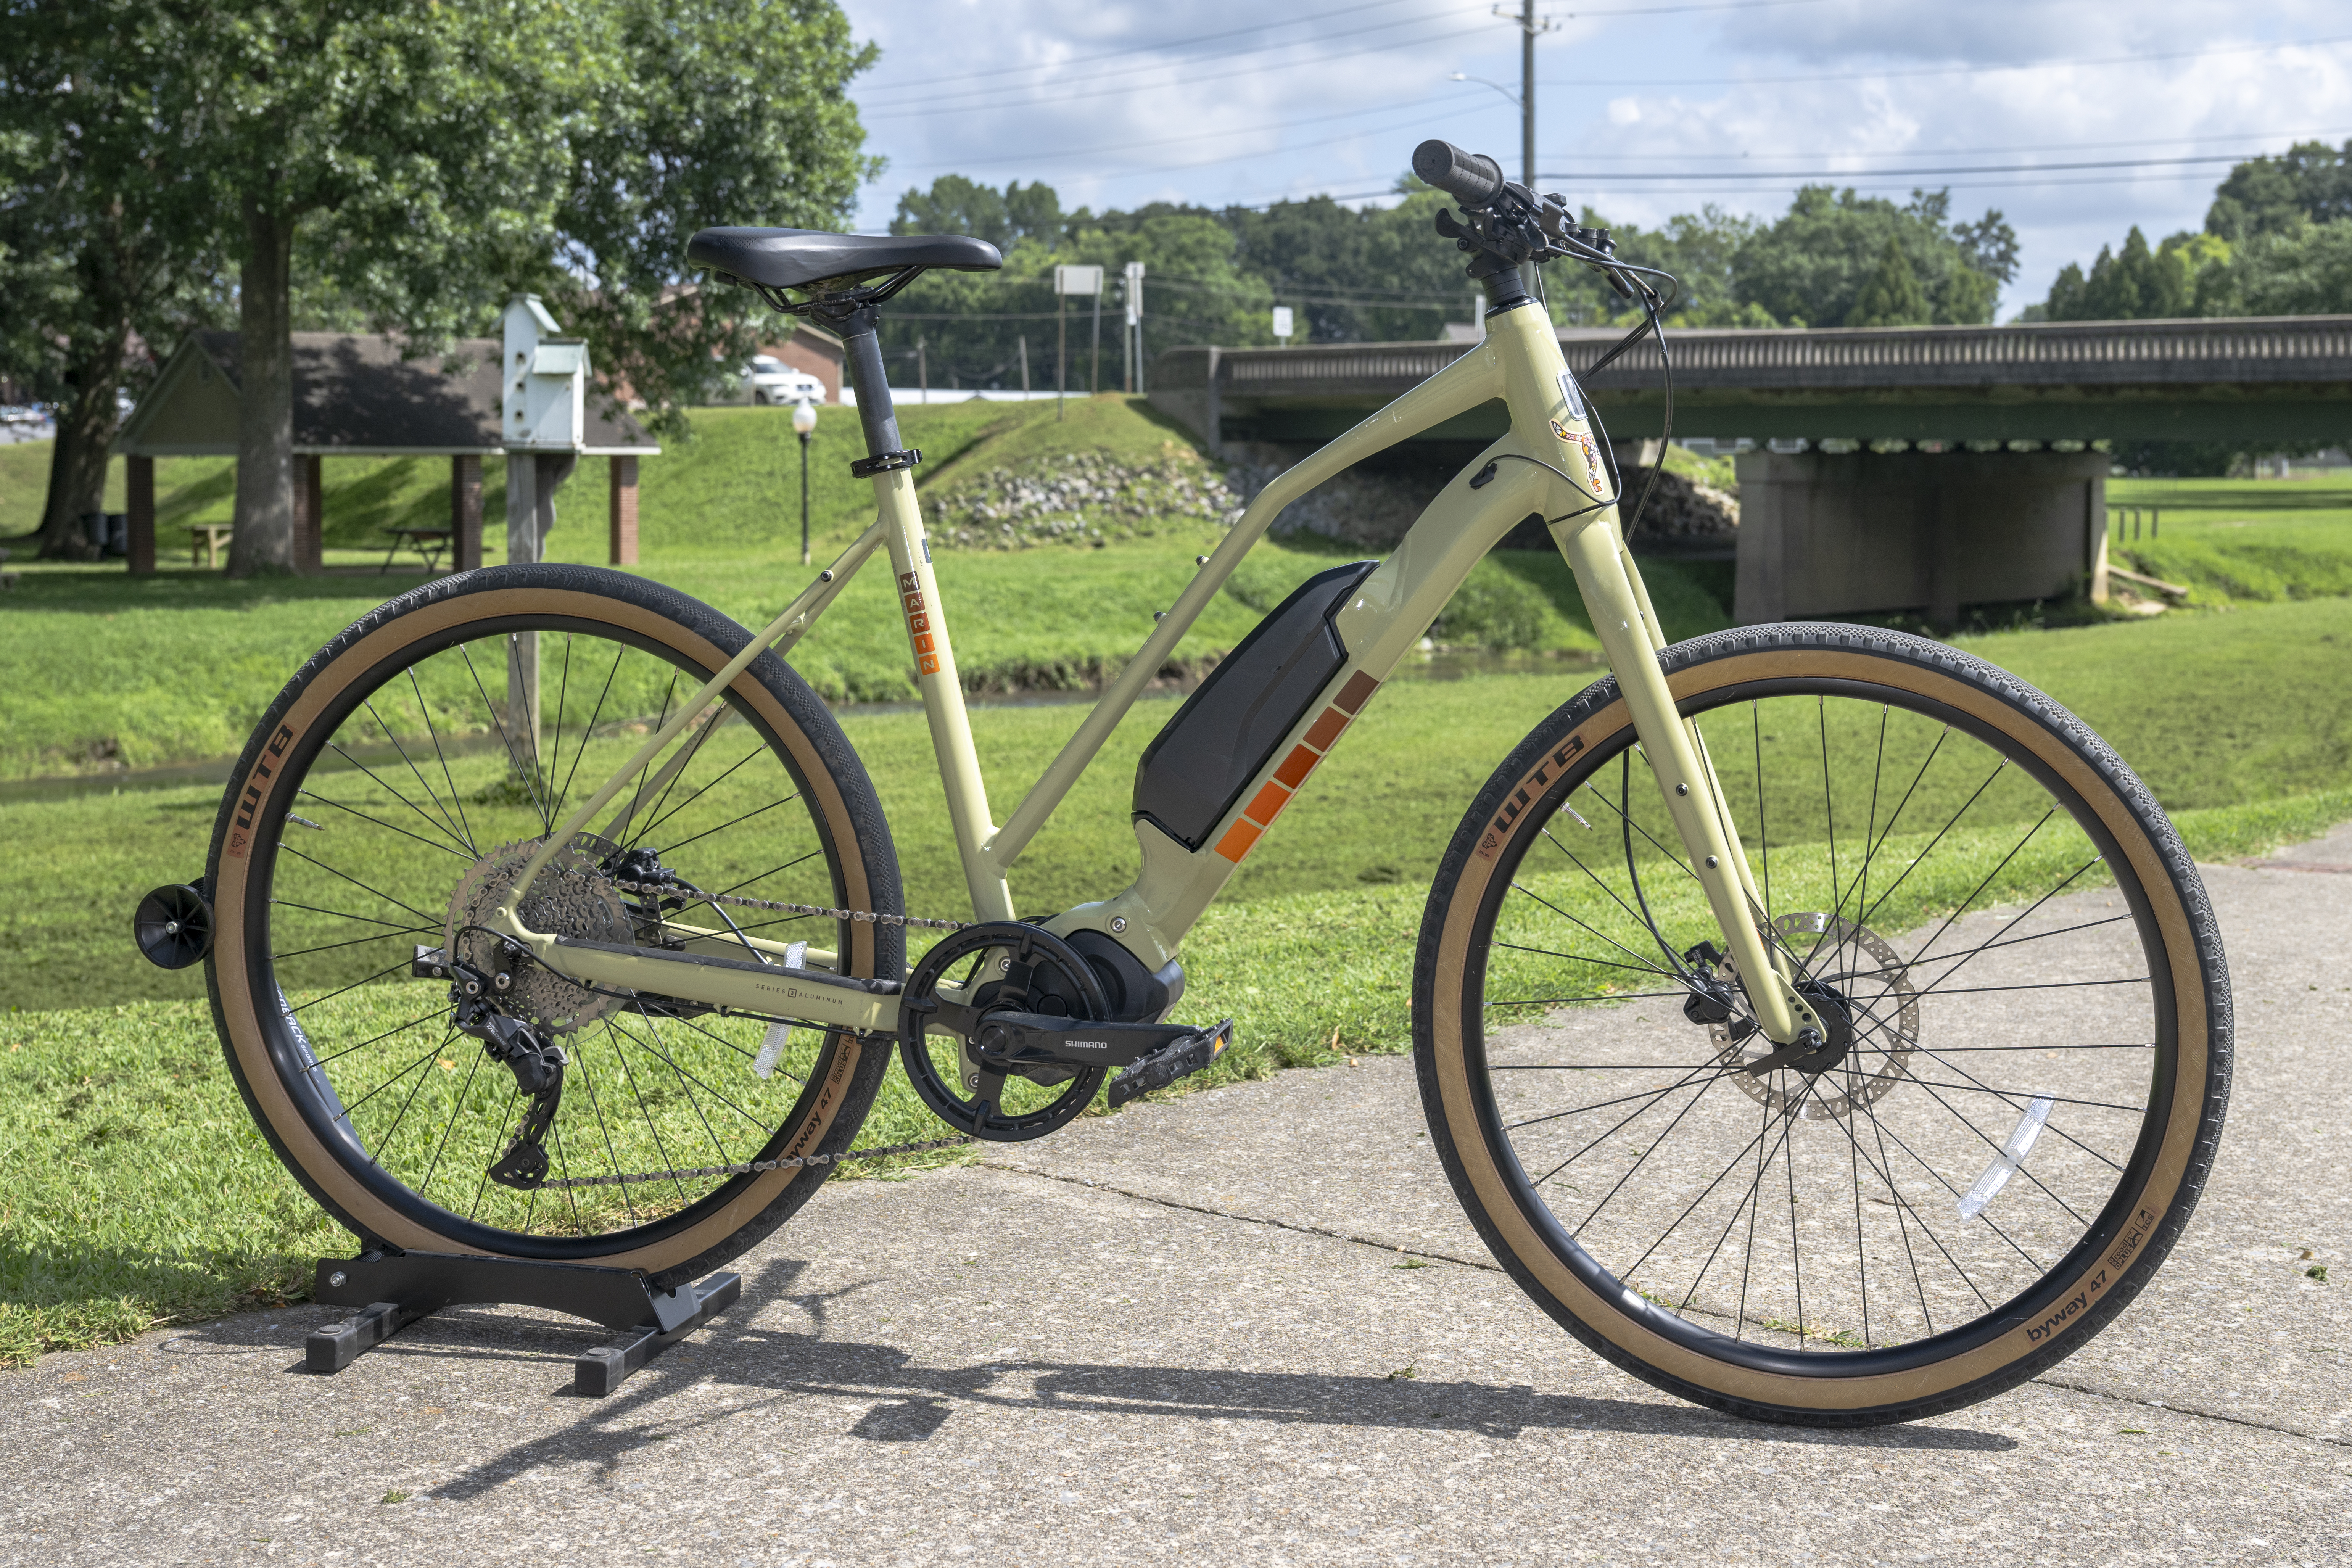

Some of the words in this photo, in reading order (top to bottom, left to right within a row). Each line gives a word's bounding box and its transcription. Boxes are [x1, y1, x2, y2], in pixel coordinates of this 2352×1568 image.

[903, 576, 935, 670] MARIN
[236, 724, 293, 830] WTB
[1494, 735, 1584, 833] WTB
[756, 984, 785, 994] SERIES
[799, 992, 843, 1005] ALUMINUM
[487, 1025, 507, 1046] DEORE
[1065, 1040, 1107, 1048] SHIMANO
[837, 1060, 846, 1079] PLUS
[821, 1087, 831, 1110] 47
[2143, 1215, 2153, 1230] TCS
[2119, 1246, 2133, 1265] PLUS
[2026, 1291, 2088, 1342] byway
[2091, 1269, 2107, 1293] 47
